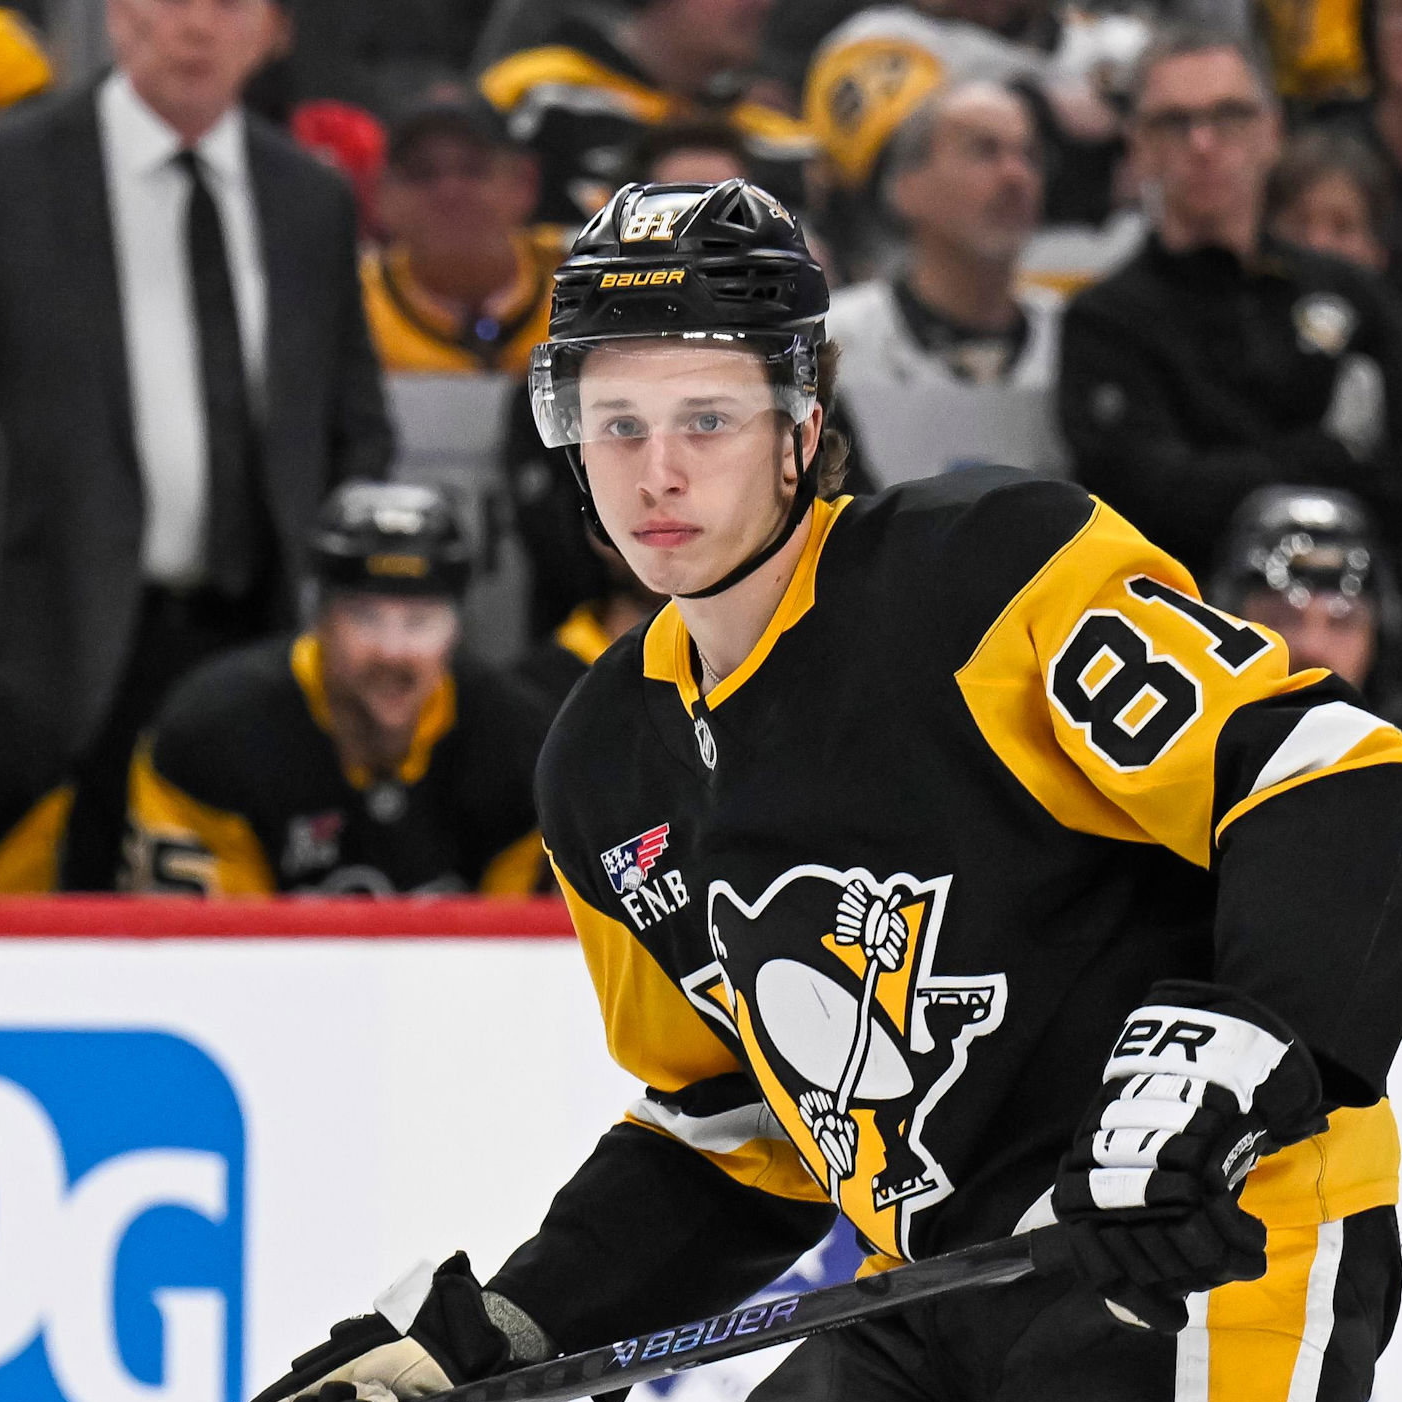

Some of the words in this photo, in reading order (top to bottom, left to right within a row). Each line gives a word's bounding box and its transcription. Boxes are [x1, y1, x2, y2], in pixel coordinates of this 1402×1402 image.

[621, 211, 677, 243] 81
[600, 269, 686, 289] BAUER
[1045, 573, 1275, 774] 81
[621, 869, 690, 931] F.N.B.
[640, 1298, 800, 1361] BAUER
